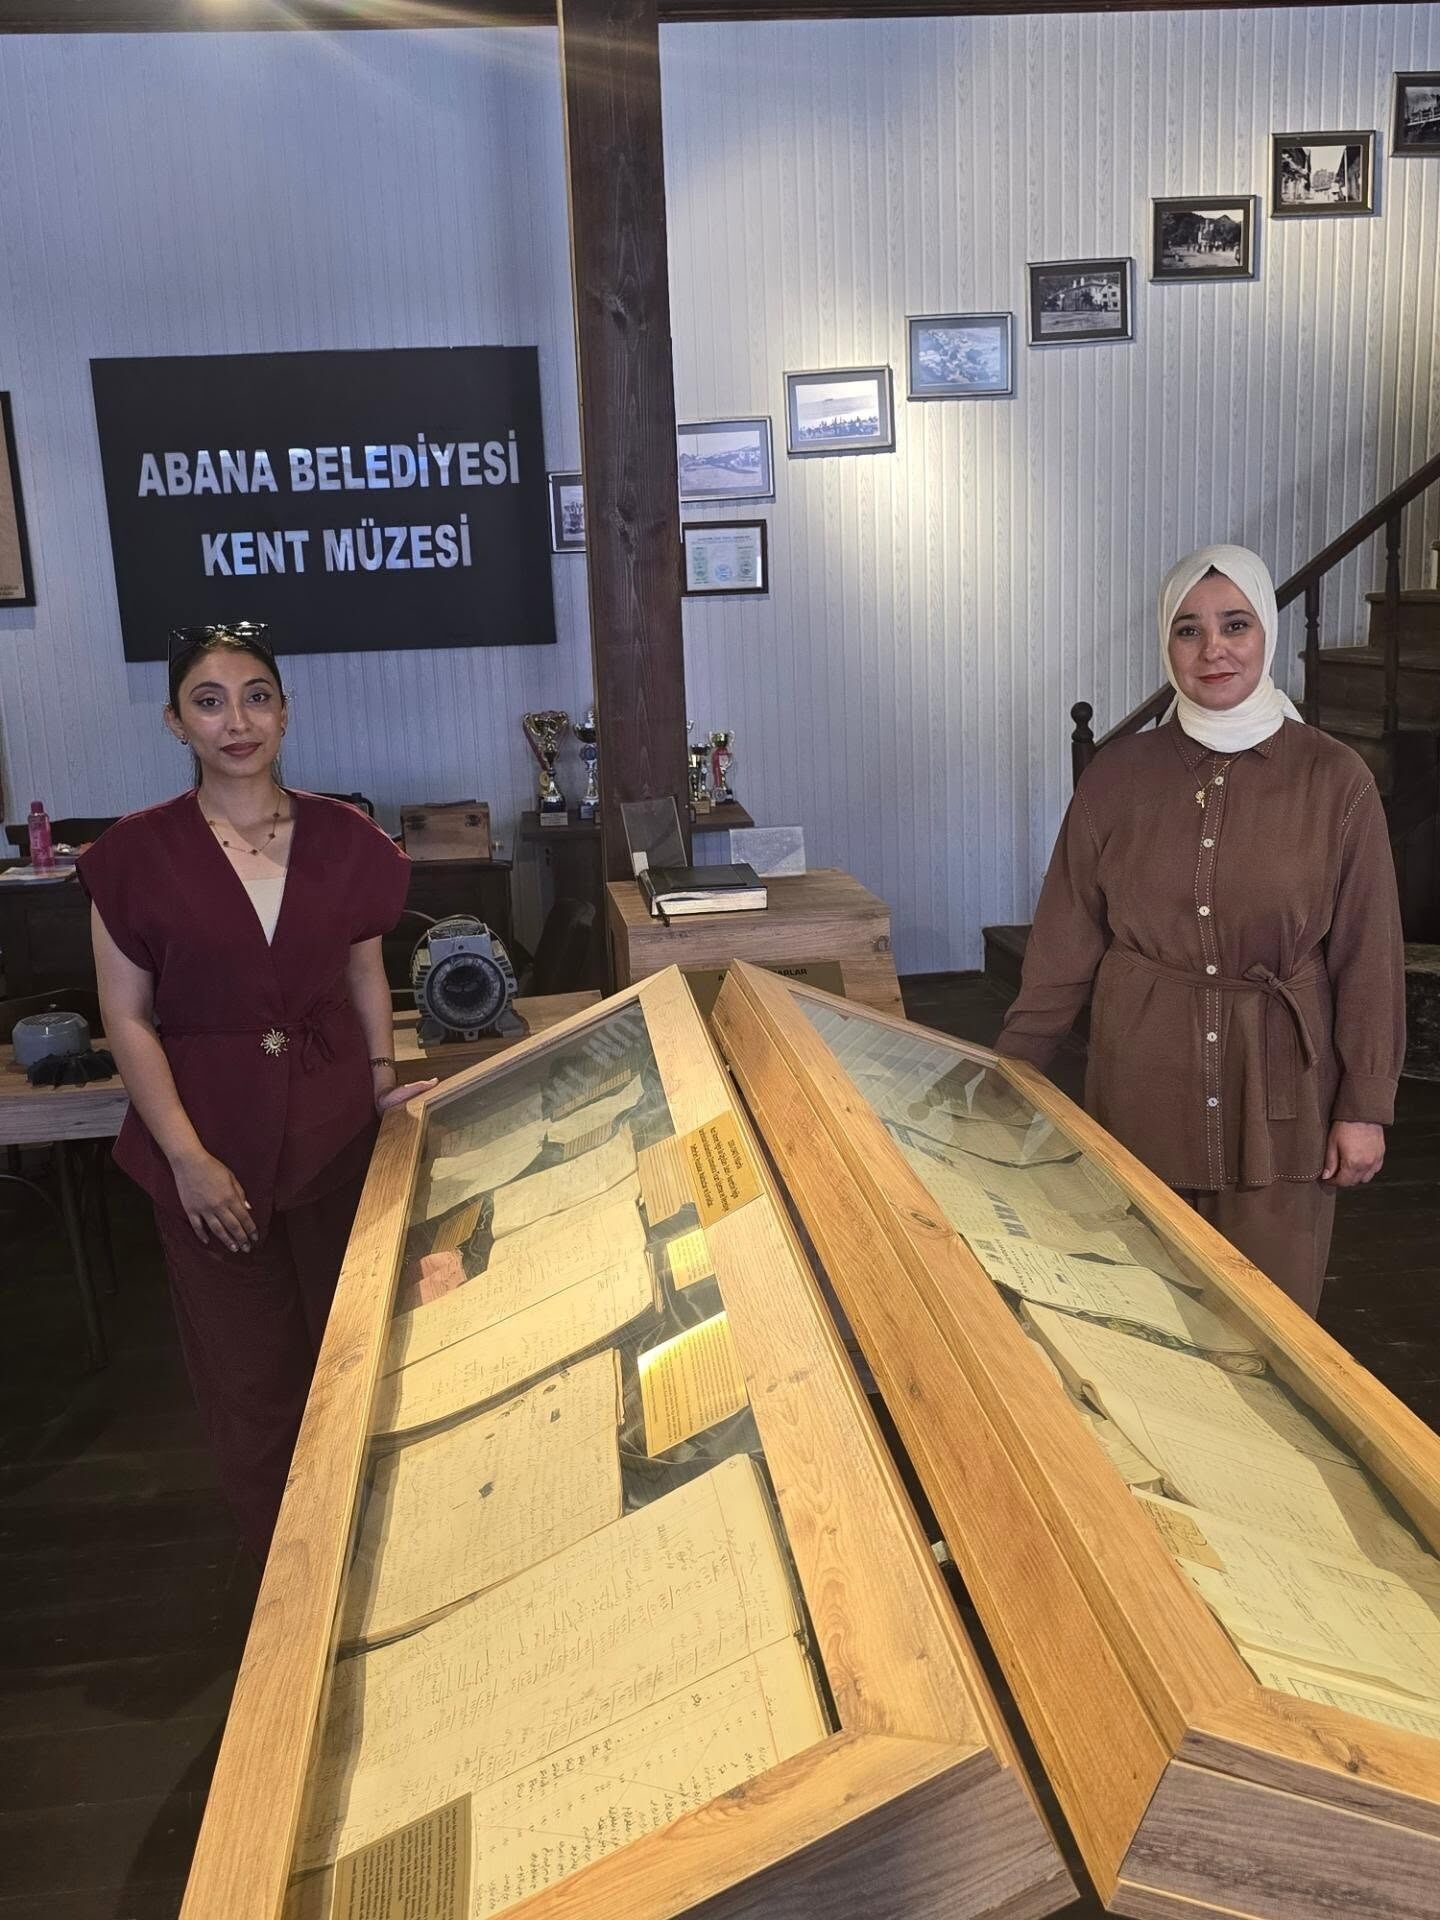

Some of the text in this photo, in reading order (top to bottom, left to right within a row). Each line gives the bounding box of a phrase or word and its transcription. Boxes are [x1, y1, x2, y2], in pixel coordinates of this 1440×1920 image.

[138, 430, 520, 497] ABANA BELEDİYESİ
[201, 513, 473, 576] KENT MÜZESİ
